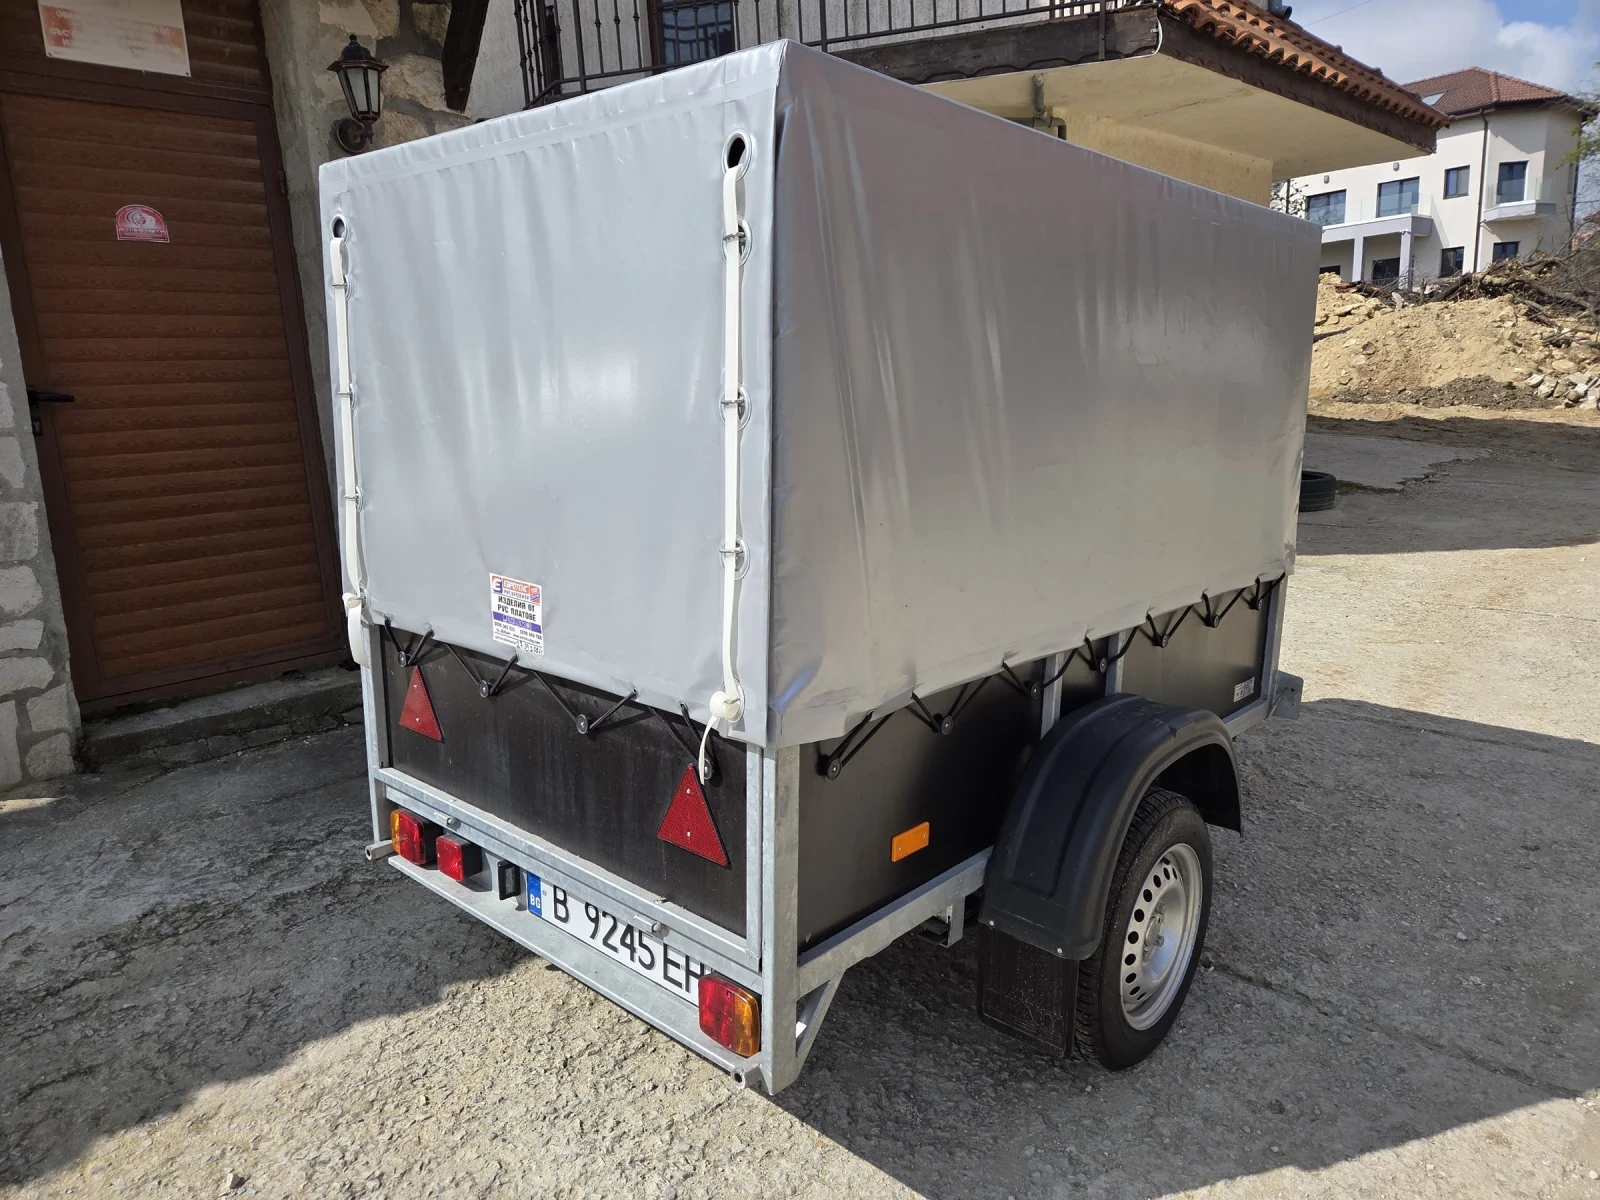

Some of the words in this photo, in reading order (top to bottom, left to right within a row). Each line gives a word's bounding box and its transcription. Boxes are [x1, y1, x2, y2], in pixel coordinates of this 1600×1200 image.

[498, 595, 526, 610] ИЗДЕЛИЯ
[528, 604, 535, 613] ОТ
[498, 604, 509, 613] PVC
[510, 608, 536, 622] ПЛАТОВЕ
[530, 893, 541, 909] BG
[553, 885, 569, 924] B
[585, 902, 655, 971] 9245
